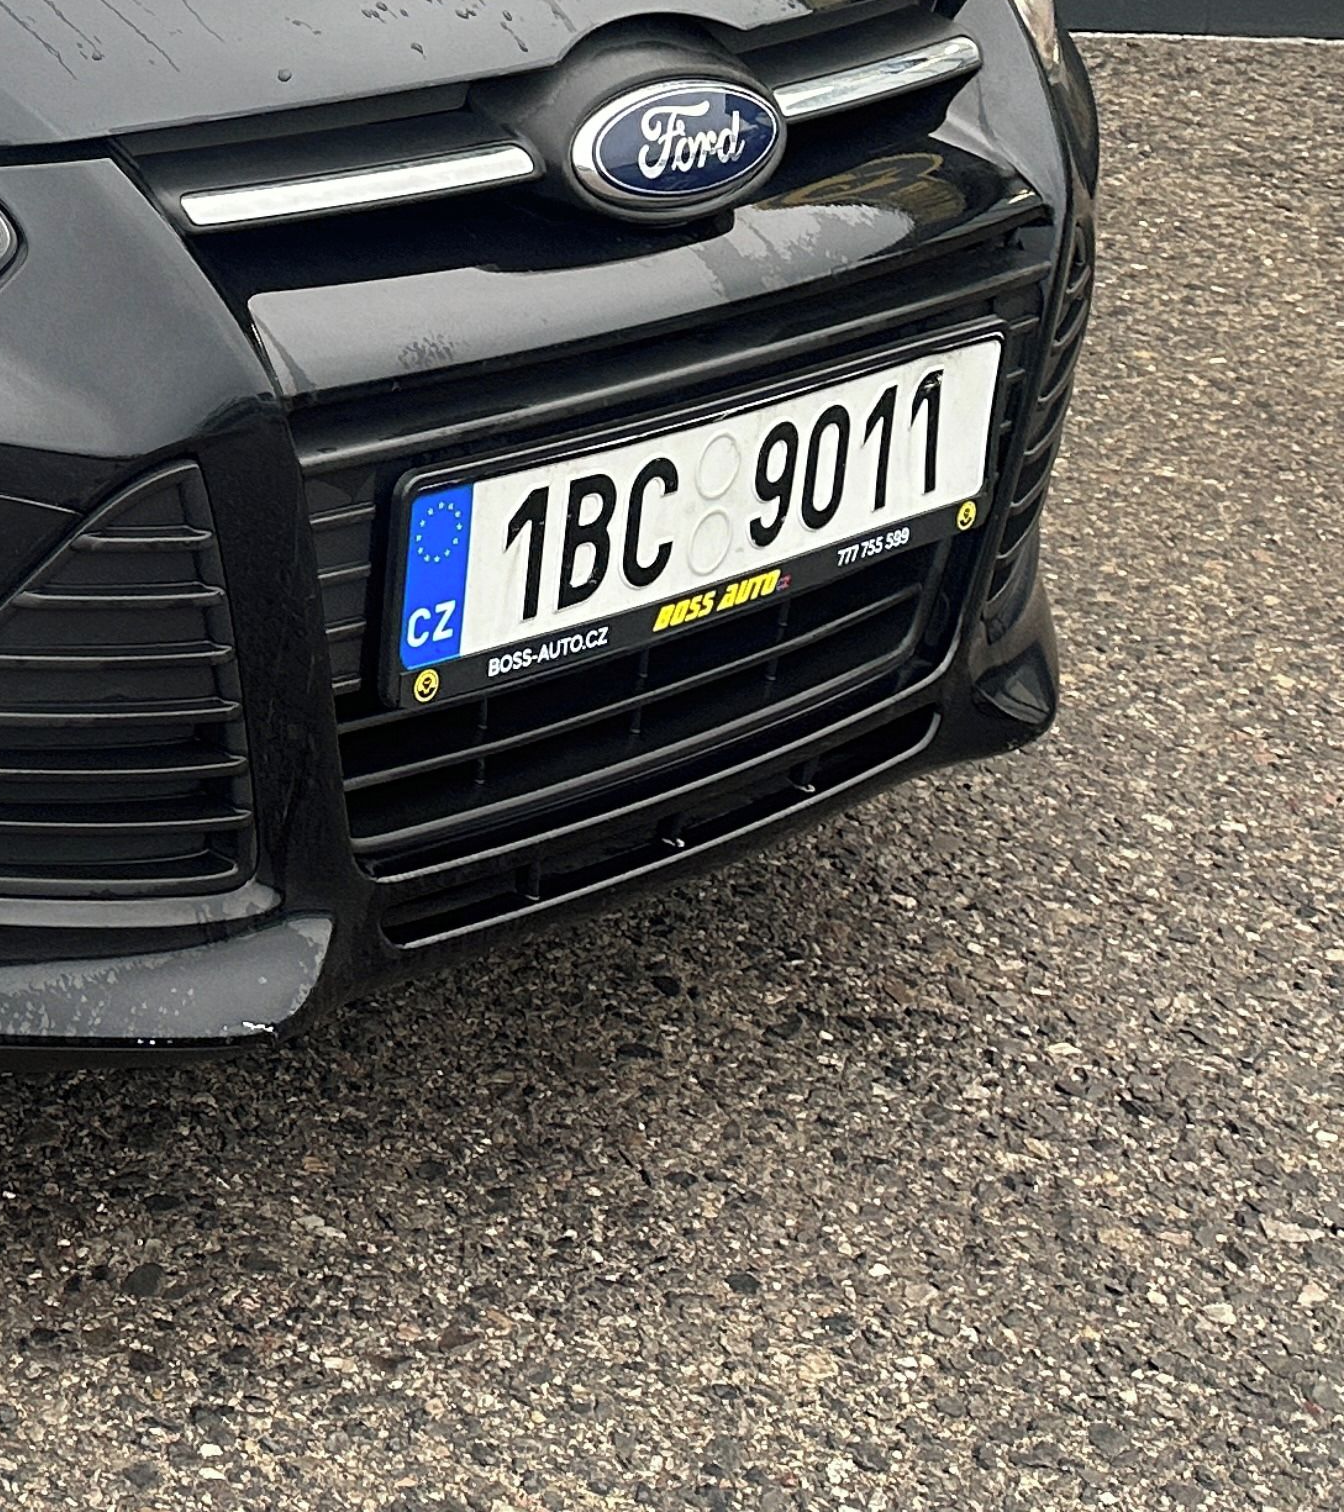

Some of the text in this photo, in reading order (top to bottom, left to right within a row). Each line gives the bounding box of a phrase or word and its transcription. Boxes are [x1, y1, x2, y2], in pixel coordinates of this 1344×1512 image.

[637, 99, 746, 180] Ford
[502, 368, 945, 624] 1BC 9011
[837, 527, 911, 567] 777 755 599
[405, 599, 457, 648] CZ
[652, 589, 717, 633] BOSS
[487, 626, 610, 677] BOSS-AUTO.CZ
